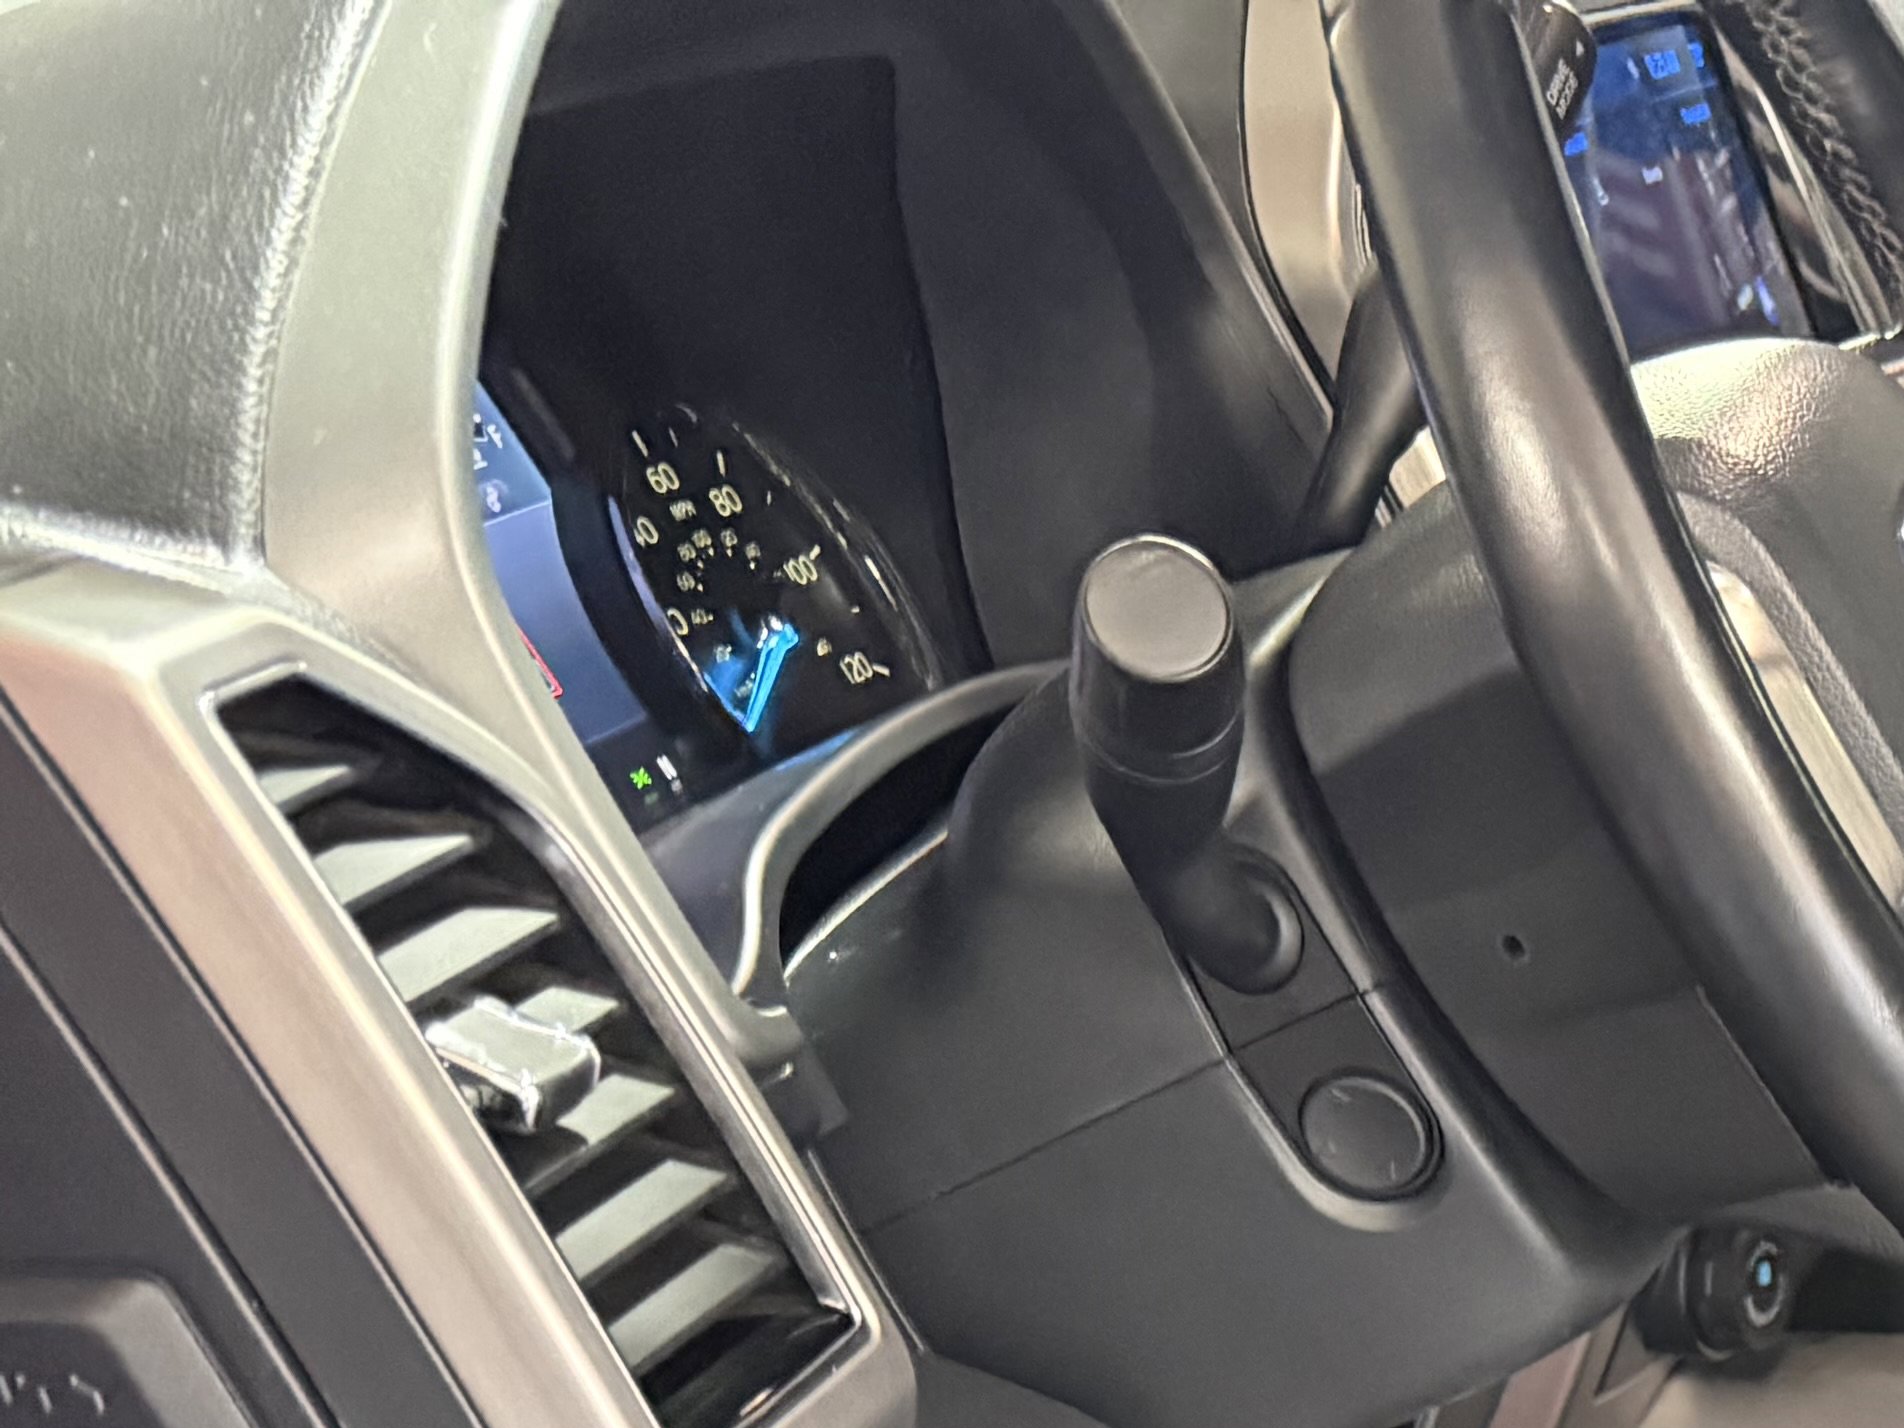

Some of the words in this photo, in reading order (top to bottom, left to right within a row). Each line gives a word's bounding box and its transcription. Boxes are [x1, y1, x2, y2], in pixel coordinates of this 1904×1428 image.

[645, 460, 681, 494] 60
[708, 483, 744, 517] 80
[783, 554, 819, 585] 100
[839, 651, 872, 684] 120
